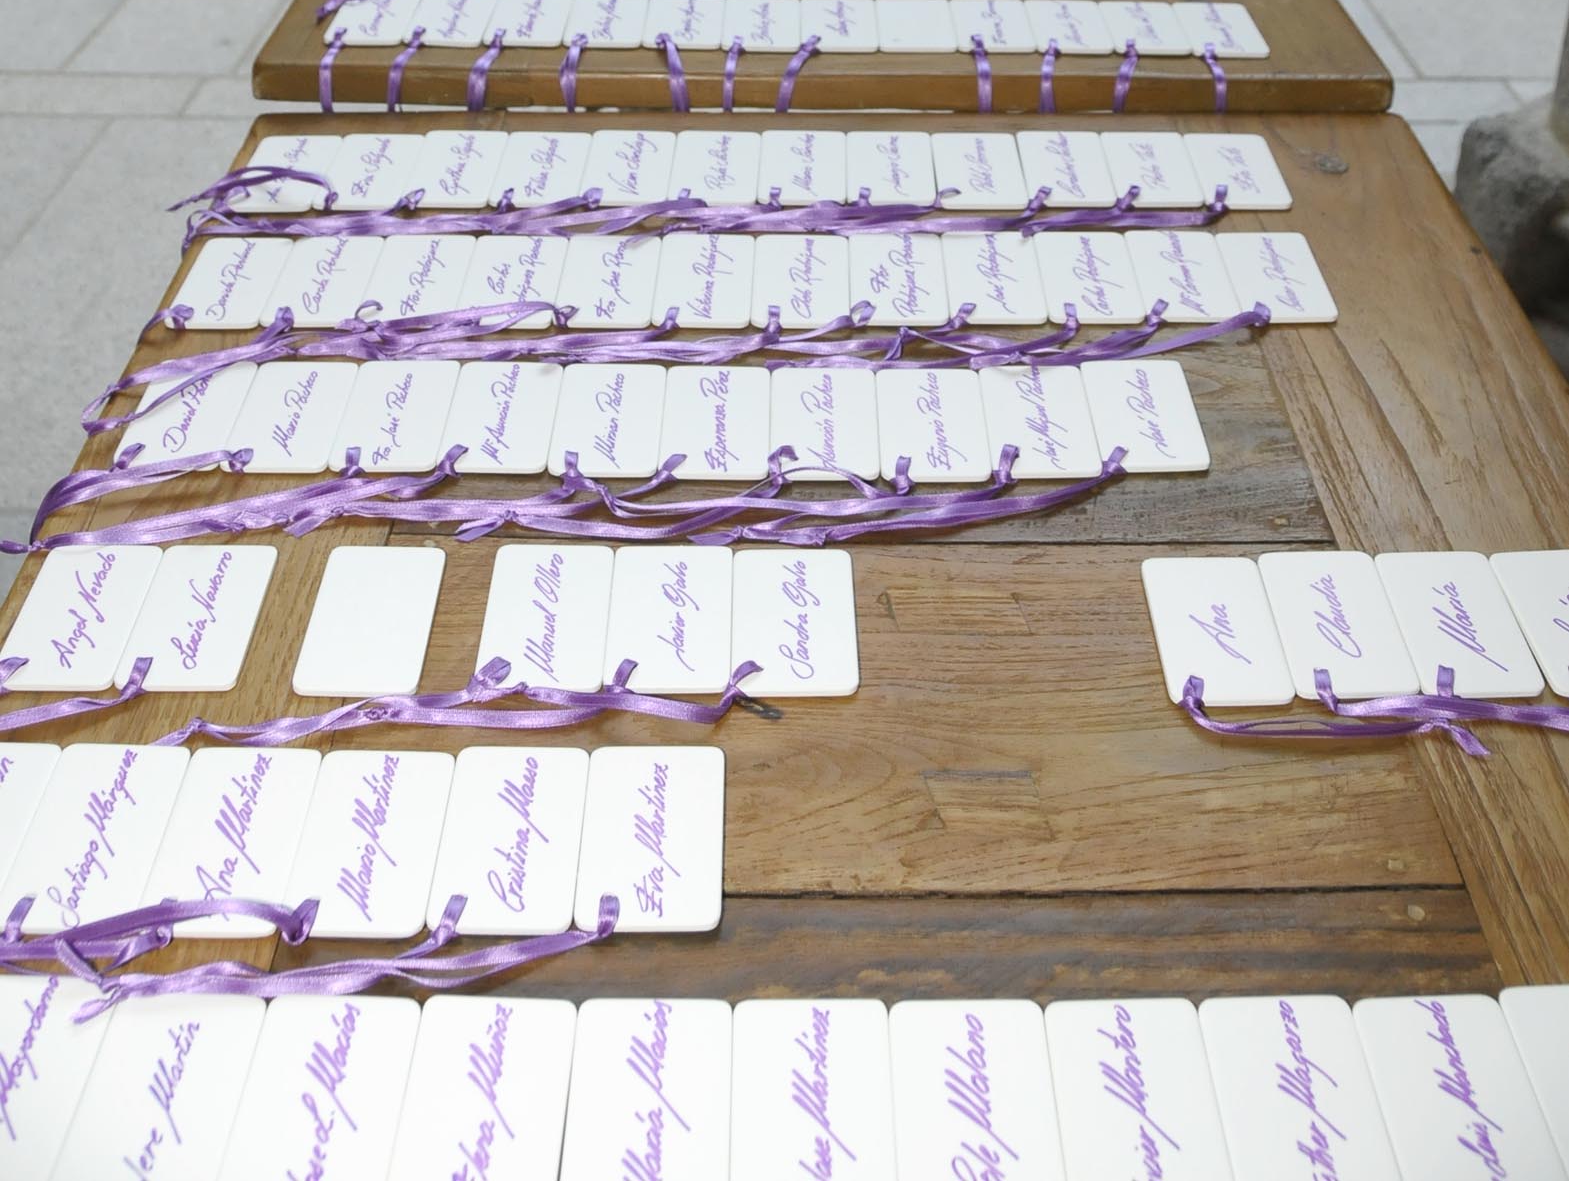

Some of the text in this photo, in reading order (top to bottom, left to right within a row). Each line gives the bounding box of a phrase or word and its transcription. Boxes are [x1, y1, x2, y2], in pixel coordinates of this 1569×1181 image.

[272, 370, 318, 457] Mario Pacheco
[386, 372, 413, 412] Pacheco
[491, 363, 520, 406] Pacheco
[595, 372, 625, 414] Pacheco
[799, 373, 834, 419] Pacheco
[917, 372, 940, 418] Pacheco
[1126, 367, 1160, 419] Pacheco
[163, 400, 199, 453] Daniel
[704, 400, 740, 472] Esperanza
[51, 552, 116, 669] Angel Nevado
[189, 550, 233, 623] Navarro
[523, 552, 564, 682] Manuel Ollero
[1308, 573, 1362, 658] Claudia
[656, 611, 695, 672] Javier
[778, 612, 815, 679] Sandra
[1188, 602, 1252, 664] Ana
[1431, 580, 1508, 672] María
[47, 749, 138, 928] Santiago Márquez
[215, 753, 273, 874] Martínez
[337, 754, 400, 922] Mario Martínez
[487, 756, 549, 913] Cristina Maeso
[633, 866, 664, 918] Eva
[469, 1004, 515, 1139] Muñoz
[1097, 1005, 1181, 1151] Montero
[1415, 1000, 1504, 1133] Manchado
